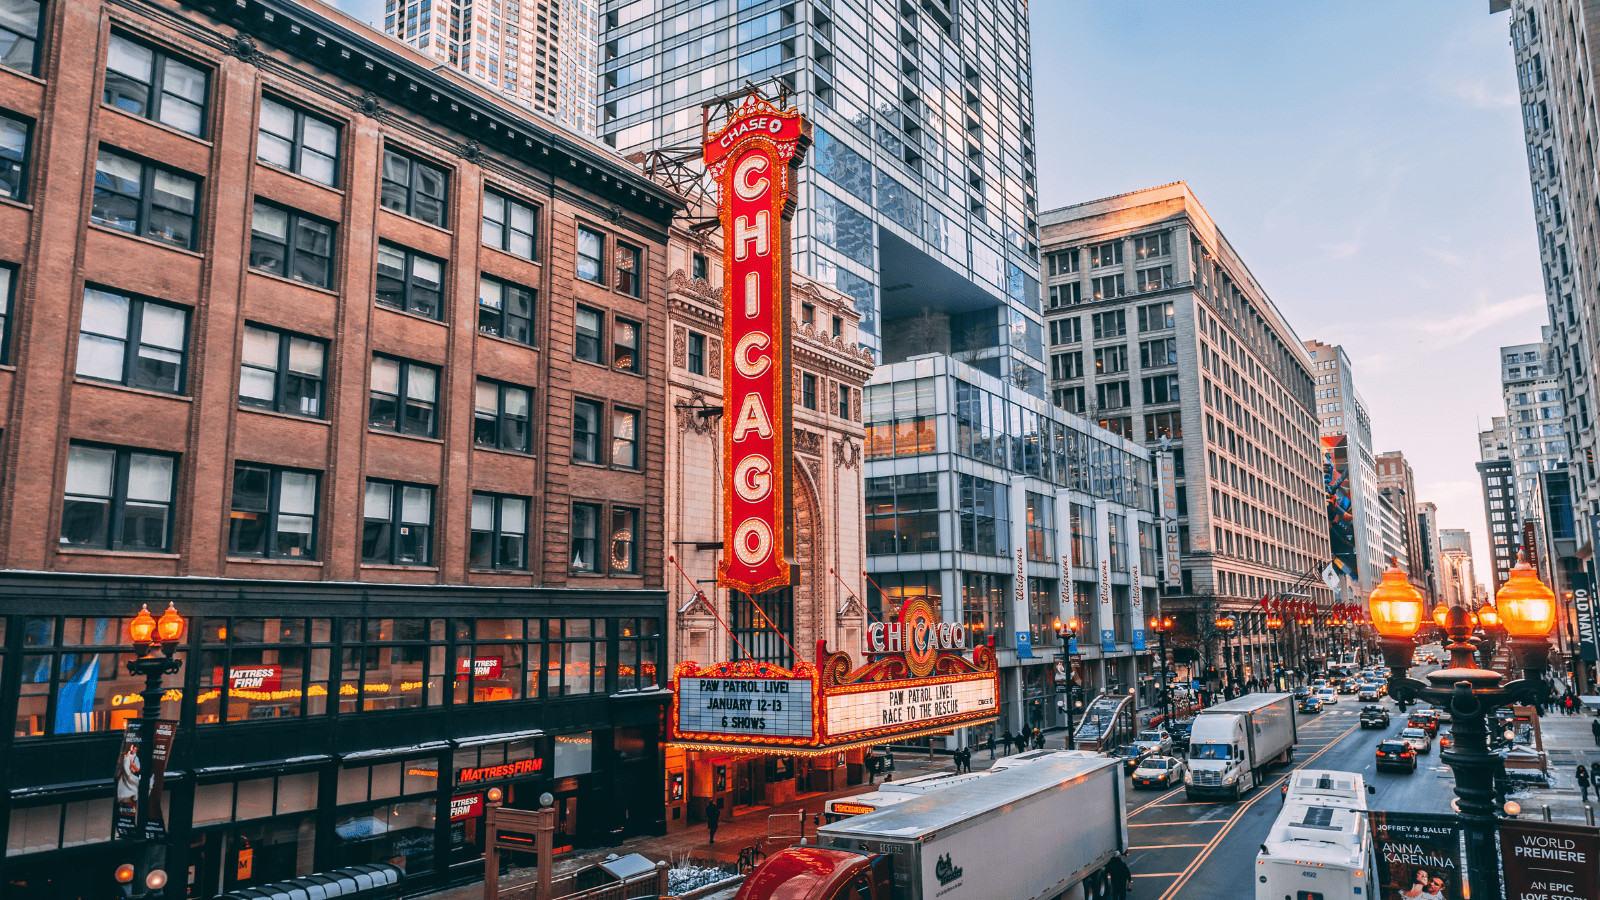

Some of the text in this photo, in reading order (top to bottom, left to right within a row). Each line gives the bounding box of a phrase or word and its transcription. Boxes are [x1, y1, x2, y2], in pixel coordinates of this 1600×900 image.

[720, 118, 768, 148] CHASE
[733, 155, 774, 568] CHICAGO
[1162, 453, 1181, 585] JOFFREY BALLET
[1015, 547, 1028, 601] Walgreens
[1062, 554, 1072, 603] Walgreens
[1101, 560, 1111, 605] Walgreens
[1133, 565, 1142, 606] Walgreens
[1574, 588, 1594, 644] OLD NAVY
[869, 621, 965, 651] CHICAGO
[463, 659, 498, 668] MTTRESS
[474, 667, 491, 676] IRM
[233, 677, 263, 689] FIRM
[700, 680, 789, 694] PAW PATROL LIVE!
[889, 685, 953, 707] PAW PATROL LIVE!
[707, 698, 782, 711] JANUARY 12-13
[882, 699, 959, 724] RACE TO THE RESCUE
[721, 716, 766, 730] 6 SHOWS
[450, 805, 471, 817] FIRM
[1377, 824, 1452, 834] JOFFREY BALLET
[881, 844, 904, 854] 161675
[1382, 842, 1424, 855] ANNA
[1522, 835, 1576, 850] WORLD
[1384, 852, 1455, 869] KARENINA
[1515, 846, 1586, 863] PREMIERE
[1302, 870, 1317, 878] 4192
[1531, 881, 1575, 893] AN EPIC
